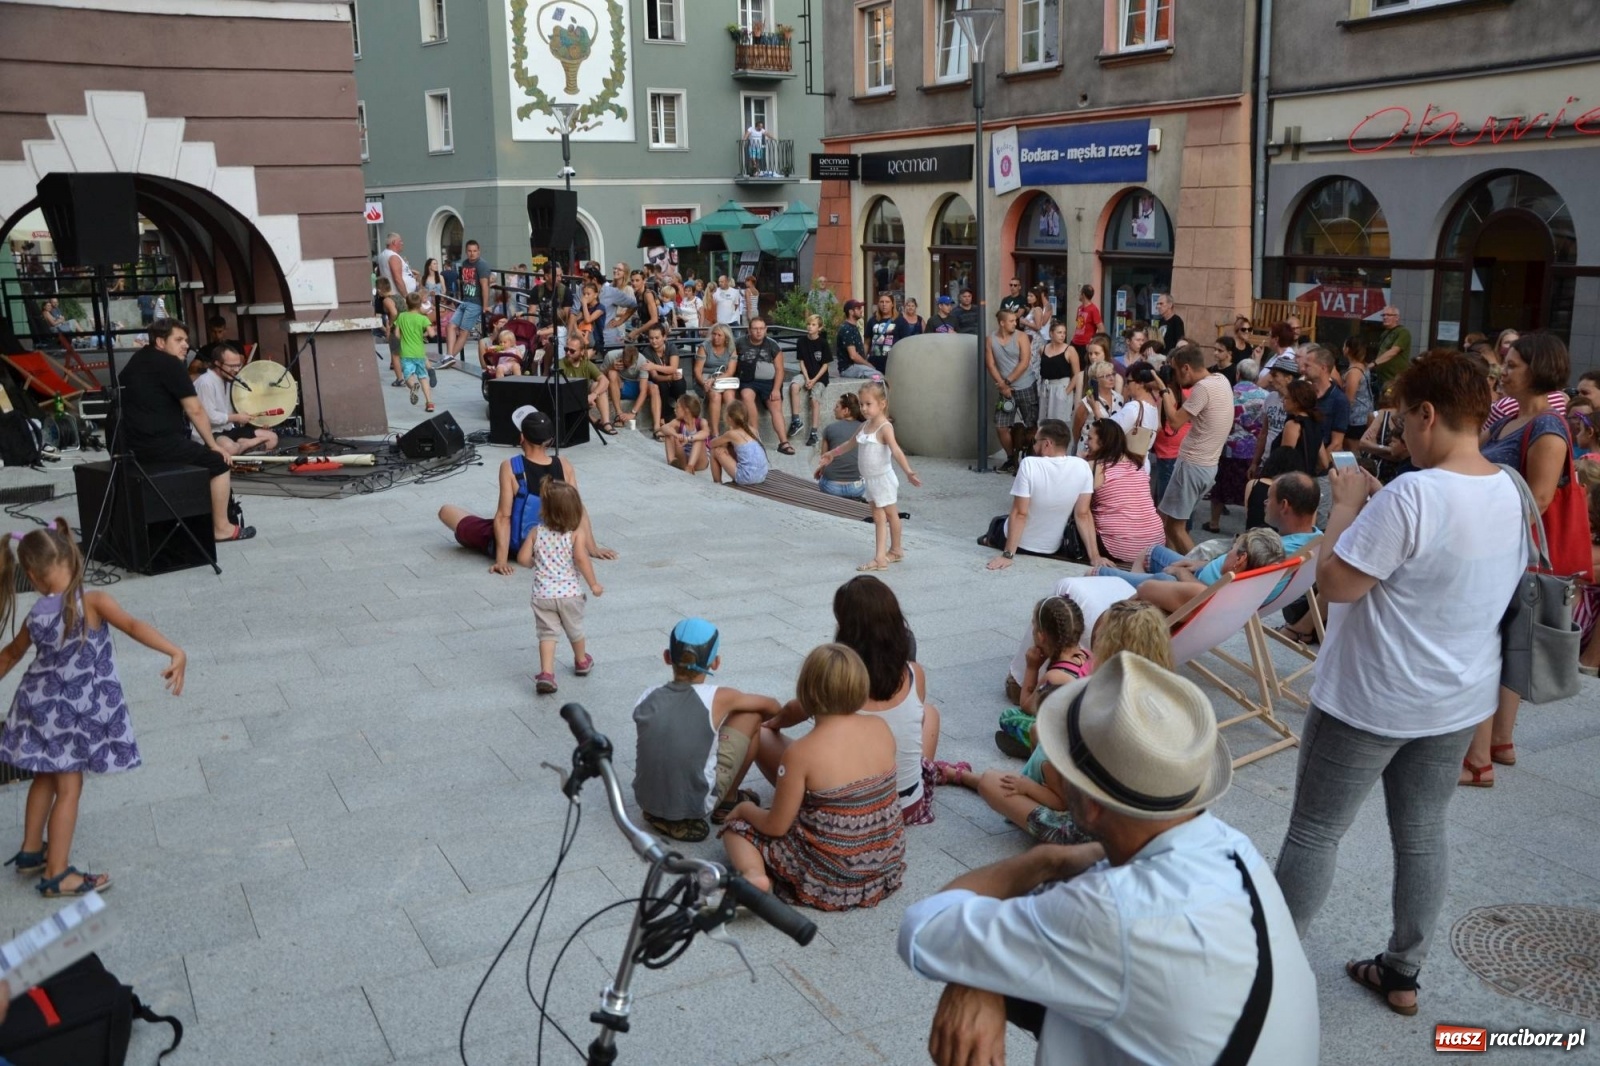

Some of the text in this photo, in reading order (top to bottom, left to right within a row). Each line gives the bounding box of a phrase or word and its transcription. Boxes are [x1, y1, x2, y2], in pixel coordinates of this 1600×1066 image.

[1020, 148, 1059, 163] Bodara
[1066, 143, 1106, 163] męska
[1108, 143, 1142, 158] rzecz
[656, 216, 689, 225] METRO
